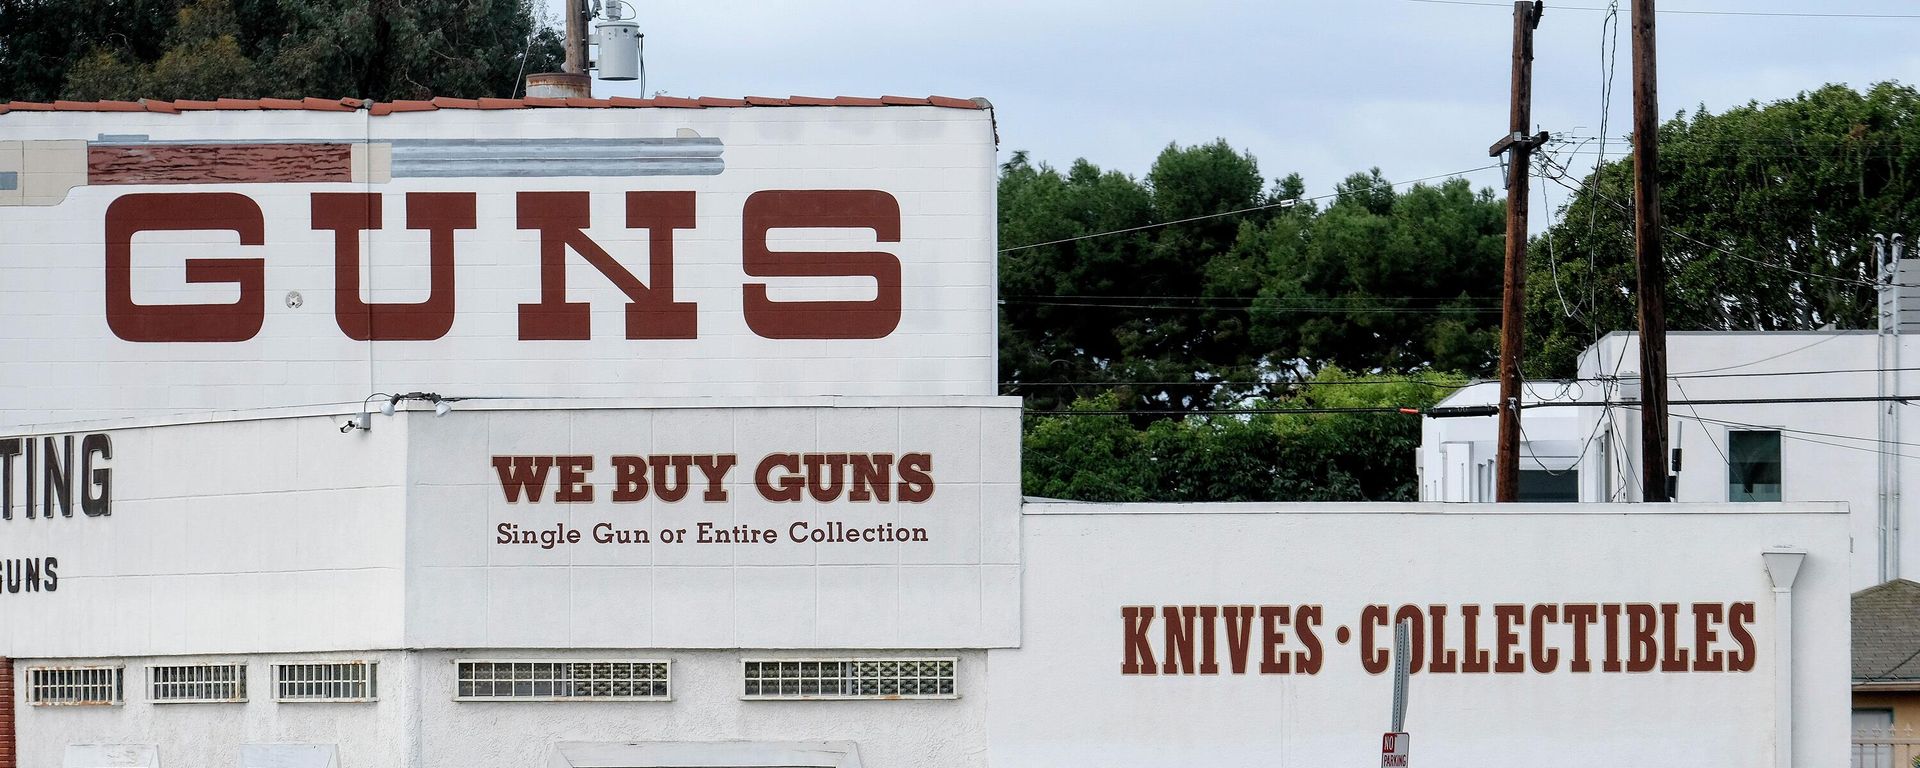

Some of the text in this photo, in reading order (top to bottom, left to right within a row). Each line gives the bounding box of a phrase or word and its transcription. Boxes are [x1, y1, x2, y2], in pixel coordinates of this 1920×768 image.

[105, 190, 902, 342] GUNS
[0, 433, 112, 520] TING
[491, 453, 935, 503] WE BUY GUNS
[496, 521, 929, 549] Single Gun or Entire Collection
[0, 556, 58, 594] UNS
[1121, 602, 1756, 676] KNIVES COLLECTIBLES
[1383, 754, 1406, 766] PARKING
[1384, 735, 1394, 750] NO
